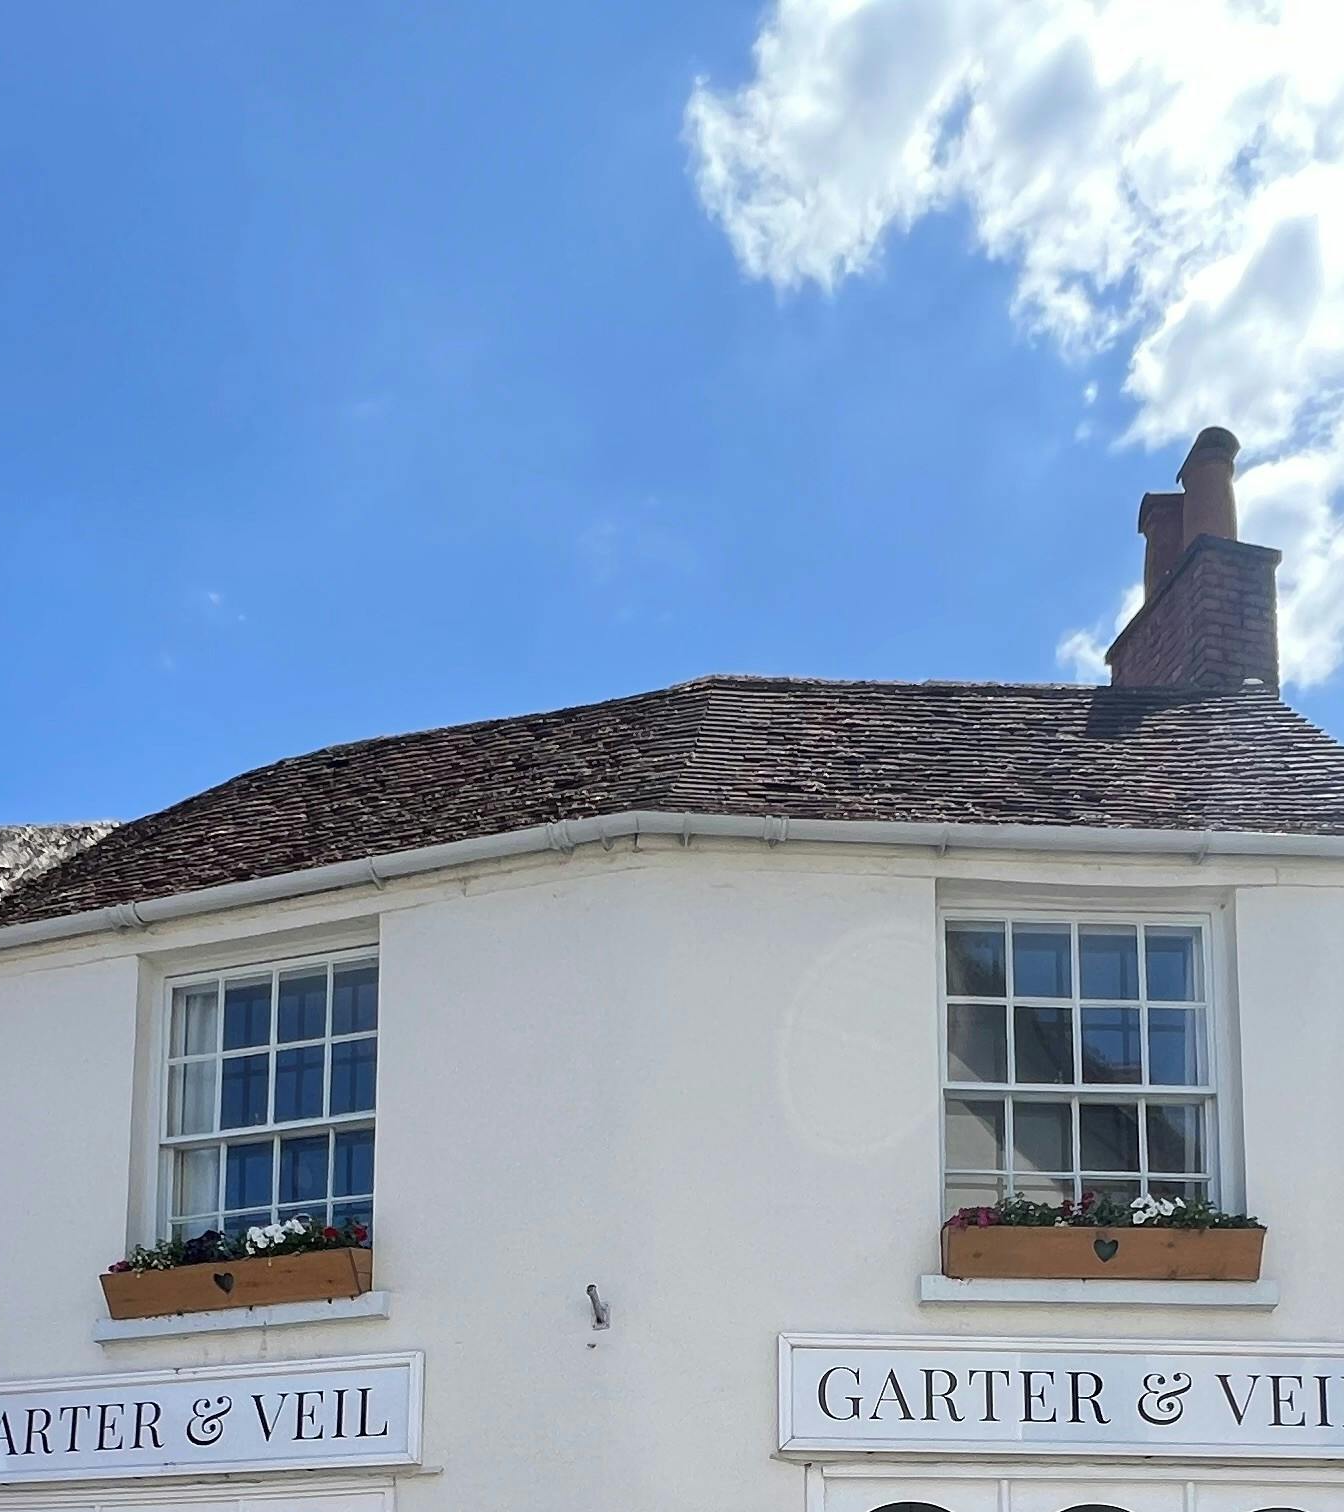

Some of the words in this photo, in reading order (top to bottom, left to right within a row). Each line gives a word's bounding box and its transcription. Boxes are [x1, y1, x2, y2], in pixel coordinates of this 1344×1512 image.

[186, 1394, 232, 1446] &
[251, 1386, 390, 1443] VEIL
[816, 1365, 1112, 1425] GARTER
[1136, 1371, 1192, 1426] &
